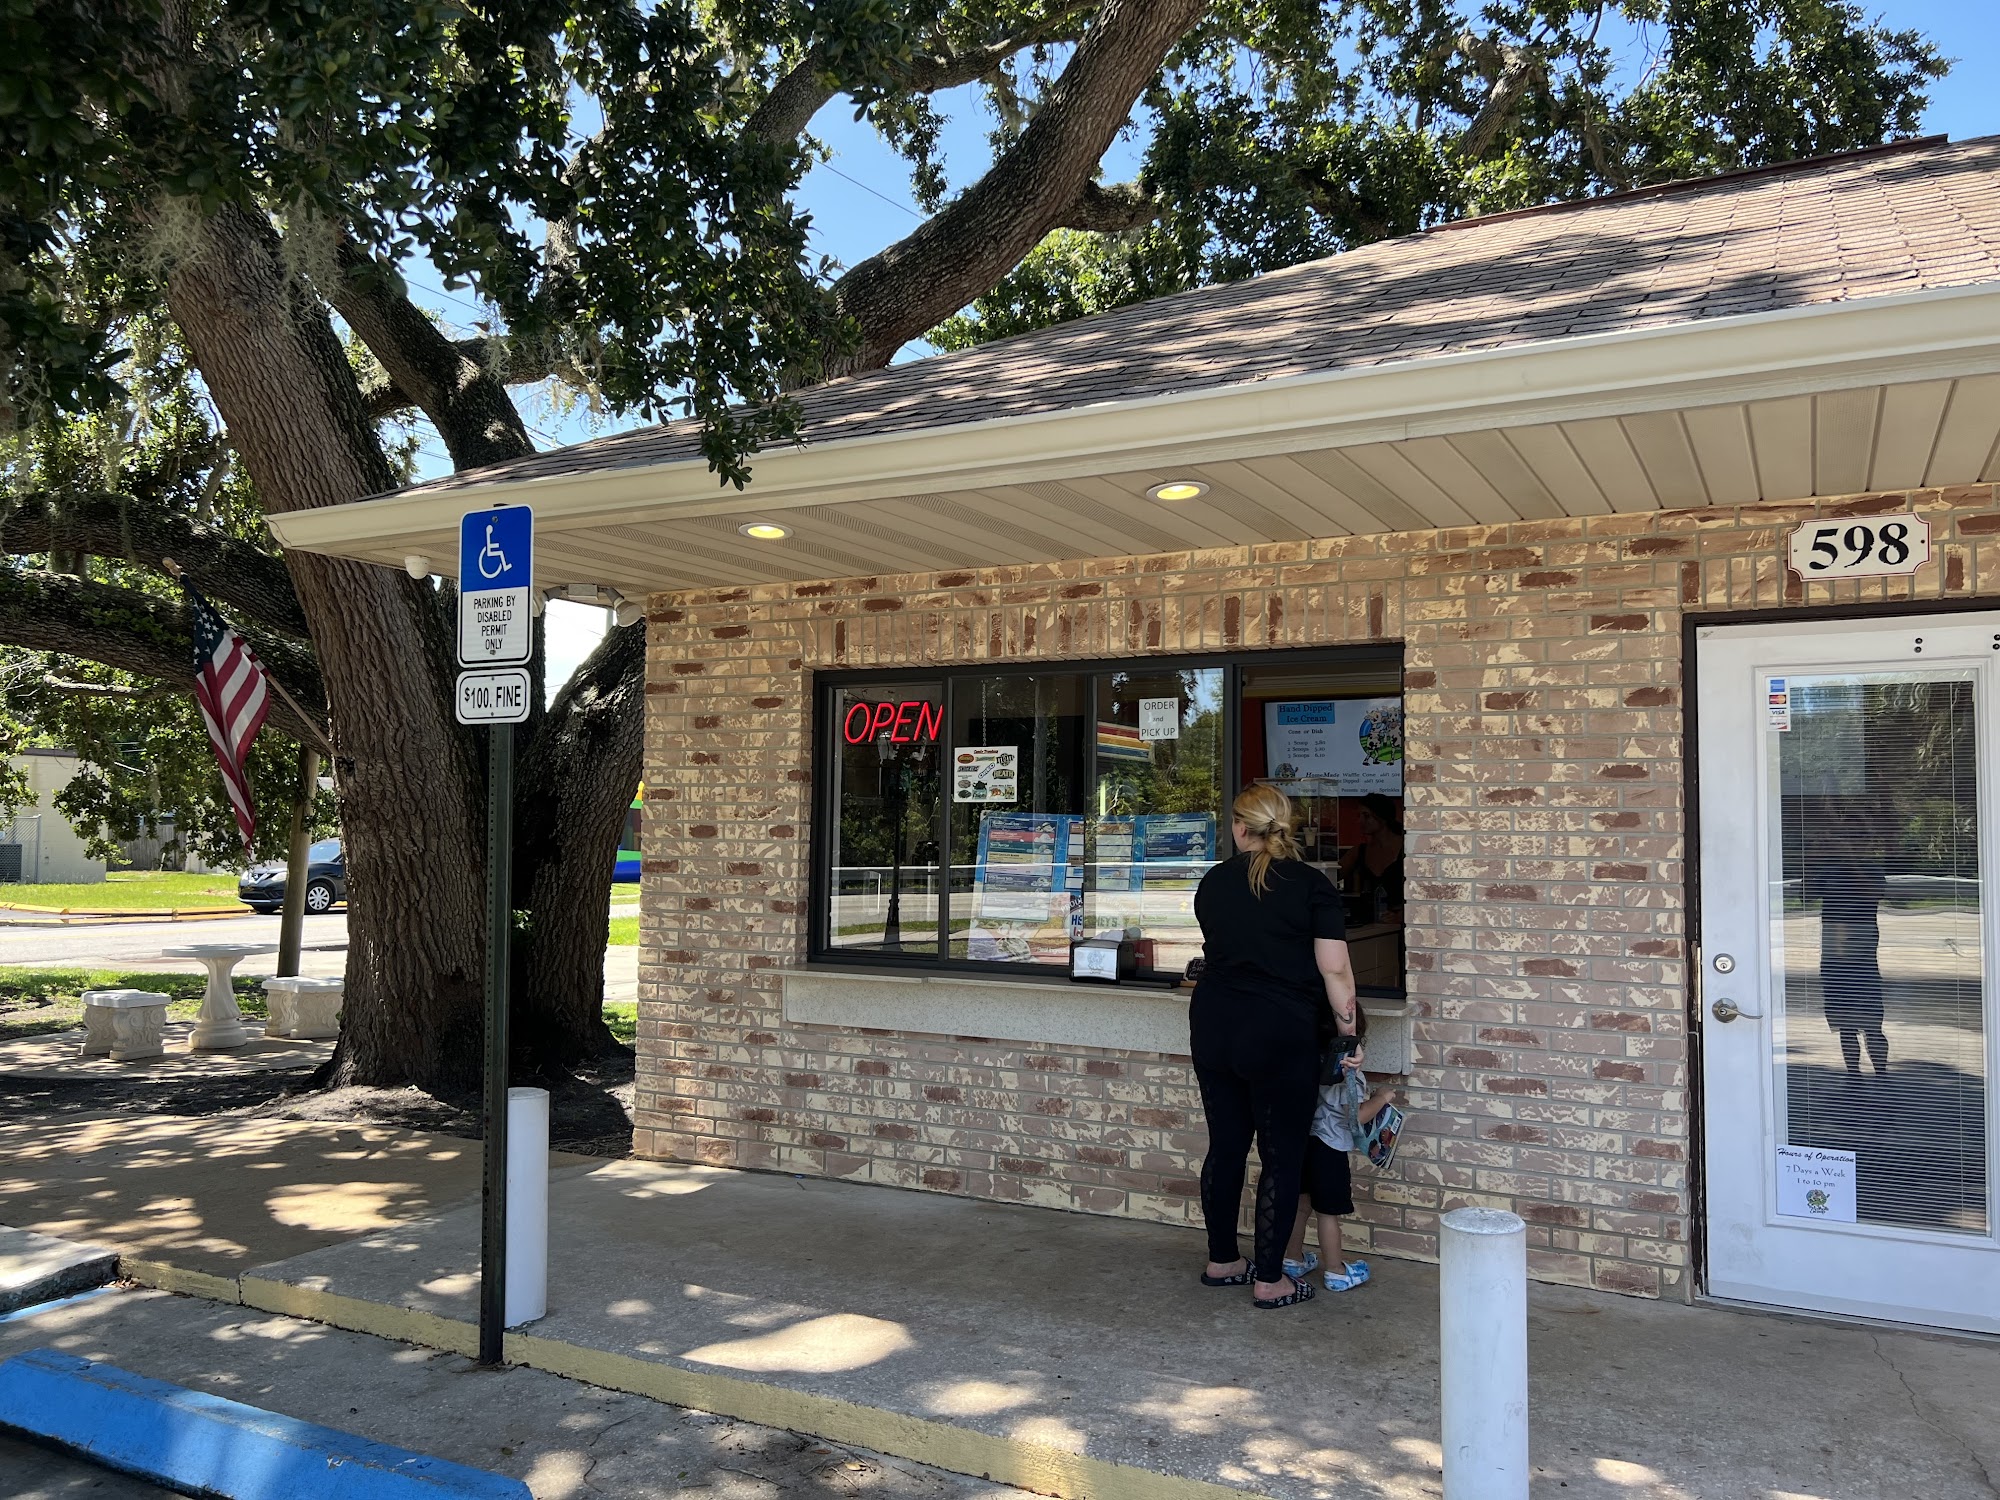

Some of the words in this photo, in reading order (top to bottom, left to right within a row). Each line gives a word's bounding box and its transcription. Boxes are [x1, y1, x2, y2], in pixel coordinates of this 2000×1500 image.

[1809, 523, 1909, 570] 598
[474, 596, 504, 610] PARKING
[506, 595, 517, 607] BY
[477, 610, 512, 623] DISABLED
[481, 624, 508, 637] PERMIT
[485, 638, 503, 651] ONLY
[496, 685, 521, 708] FINE
[1144, 701, 1175, 711] ORDER
[1279, 705, 1301, 713] Hand
[1303, 704, 1333, 713] Dipped
[844, 701, 943, 743] OPEN
[1287, 715, 1299, 723] Ice
[1300, 715, 1327, 723] Cream
[1141, 728, 1161, 737] PICK
[1163, 728, 1176, 736] UP
[993, 770, 1013, 778] HEATH
[1777, 1148, 1802, 1157] Hours
[1804, 1152, 1813, 1161] of
[1815, 1152, 1854, 1163] Operation
[1793, 1164, 1812, 1174] Days
[1821, 1167, 1846, 1178] Week
